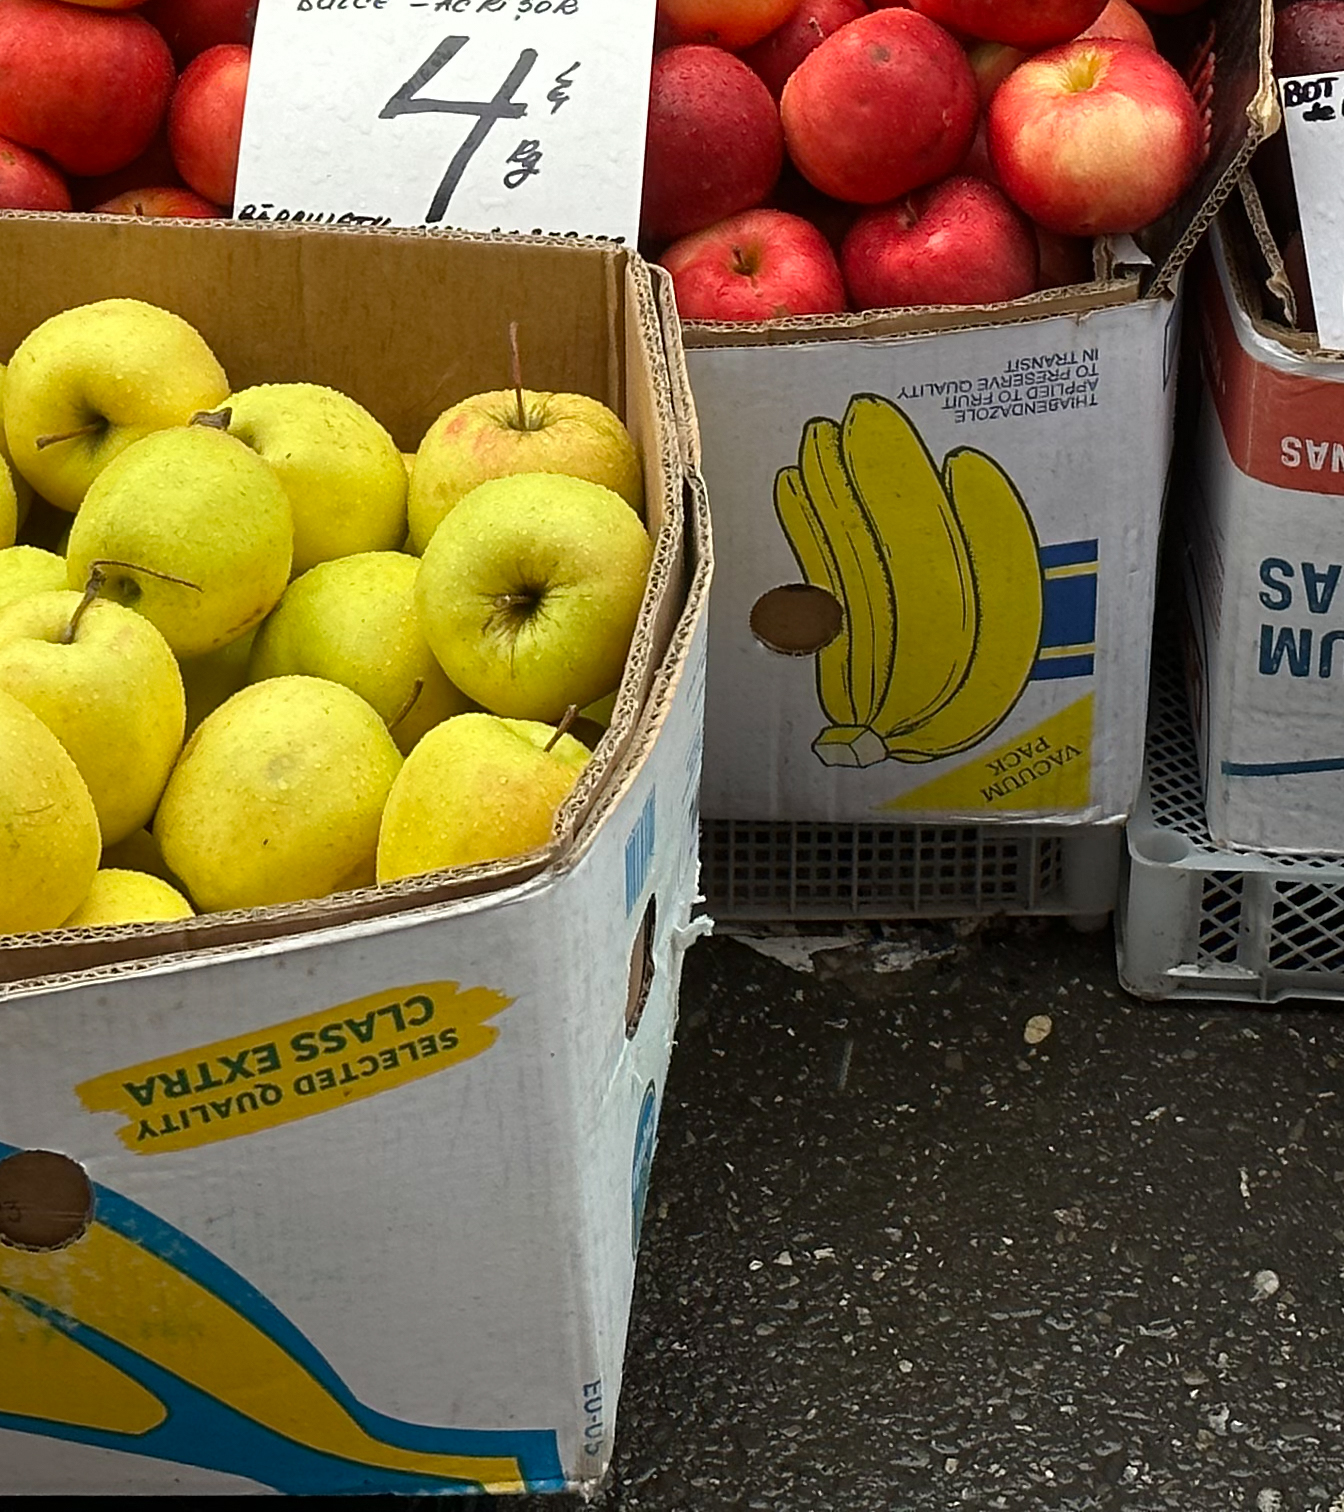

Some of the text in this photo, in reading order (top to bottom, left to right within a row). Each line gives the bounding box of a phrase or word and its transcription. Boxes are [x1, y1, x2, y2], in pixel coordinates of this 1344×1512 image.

[1284, 77, 1339, 107] BOT
[378, 34, 538, 224] 4
[1003, 348, 1099, 373] IN TRANSIT
[897, 363, 1099, 399] TO PRESERVE QUALITY
[941, 377, 1099, 410] APPLIED TO FRUIT
[954, 393, 1098, 423] THIABENDAZOLE
[982, 743, 1083, 803] VACUUM
[986, 734, 1051, 776] PACK
[122, 994, 436, 1108] CLASS EXTRA
[135, 1027, 460, 1142] SELECTED QUALITY
